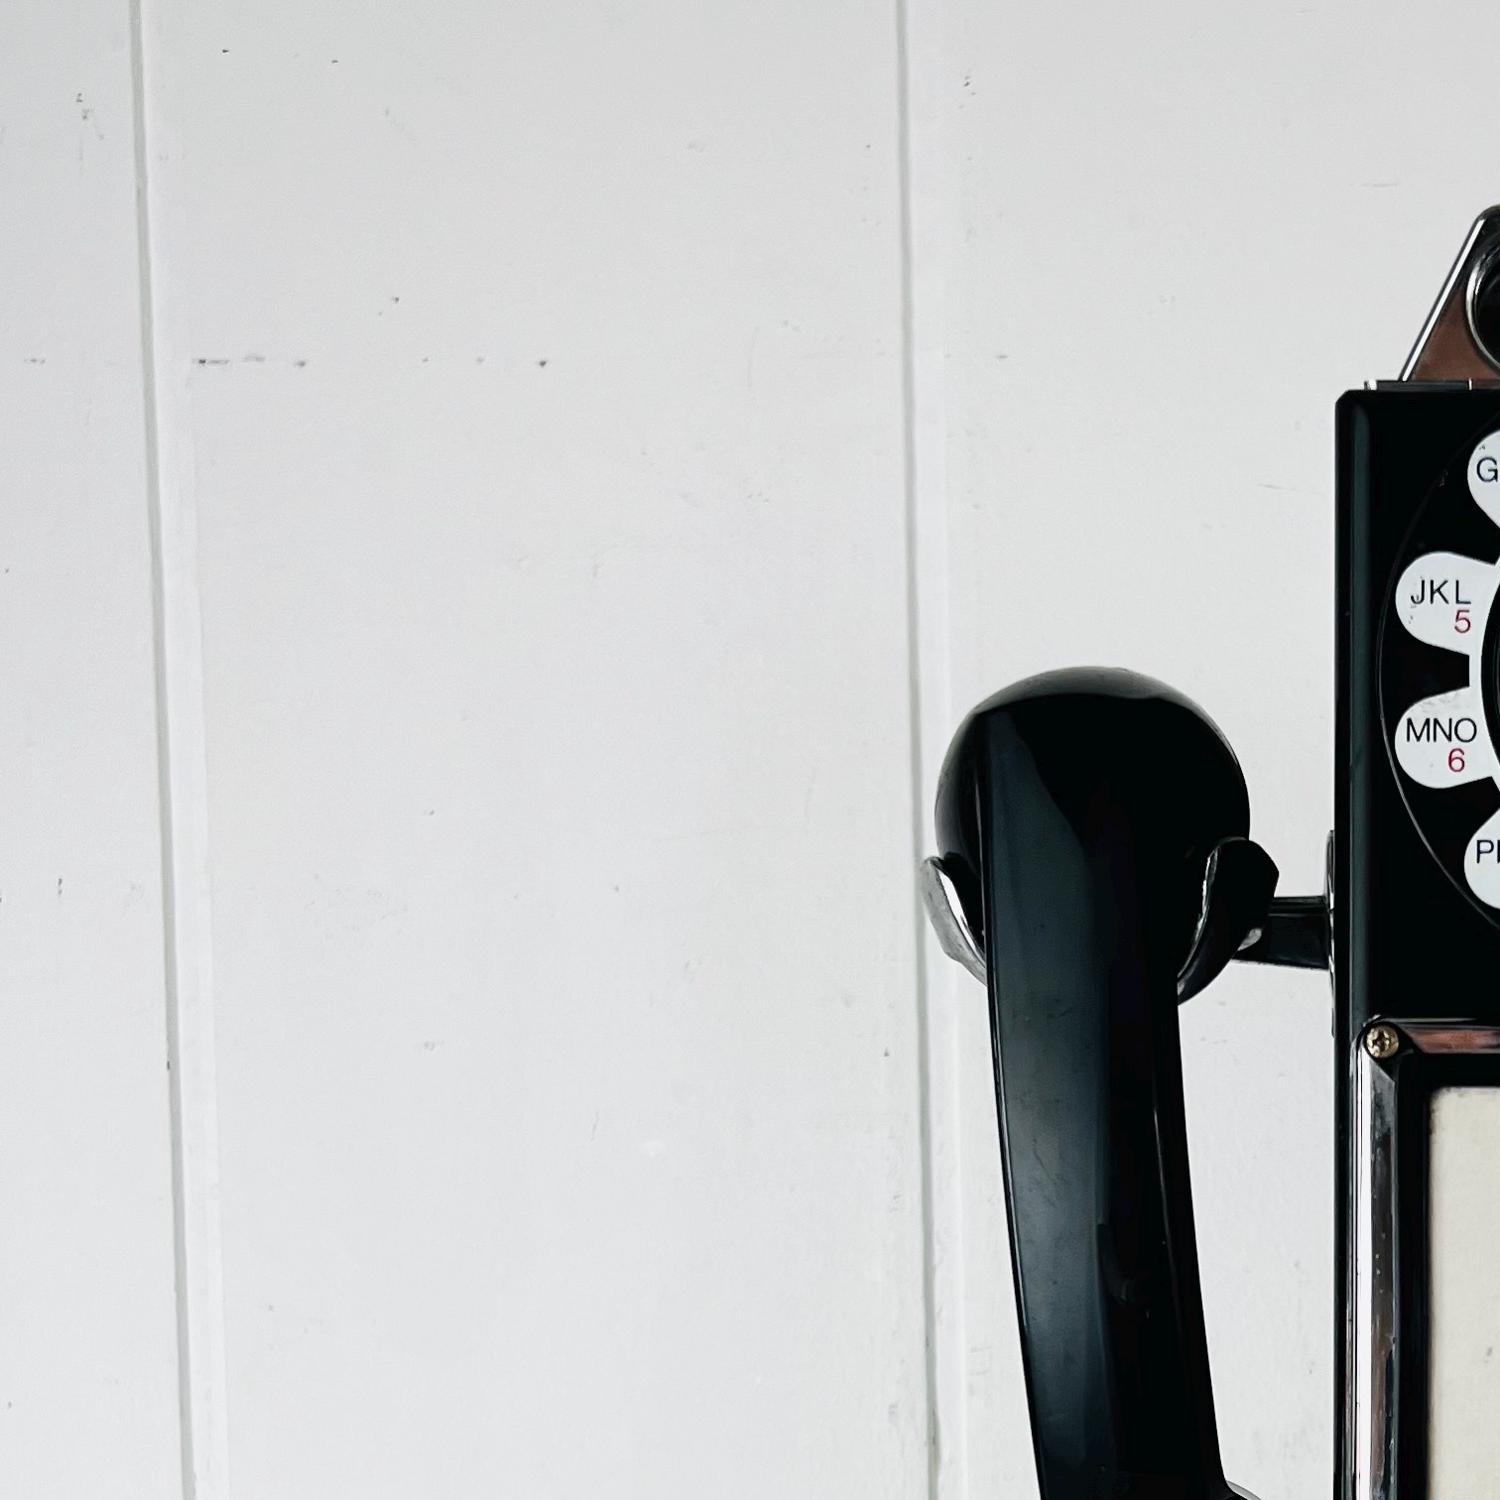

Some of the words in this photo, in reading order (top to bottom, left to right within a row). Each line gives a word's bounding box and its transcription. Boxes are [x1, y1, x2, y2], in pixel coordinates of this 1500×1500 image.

[1410, 579, 1472, 605] JKL
[1453, 609, 1472, 634] 5
[1406, 717, 1478, 743] MNO
[1447, 748, 1466, 773] 6
